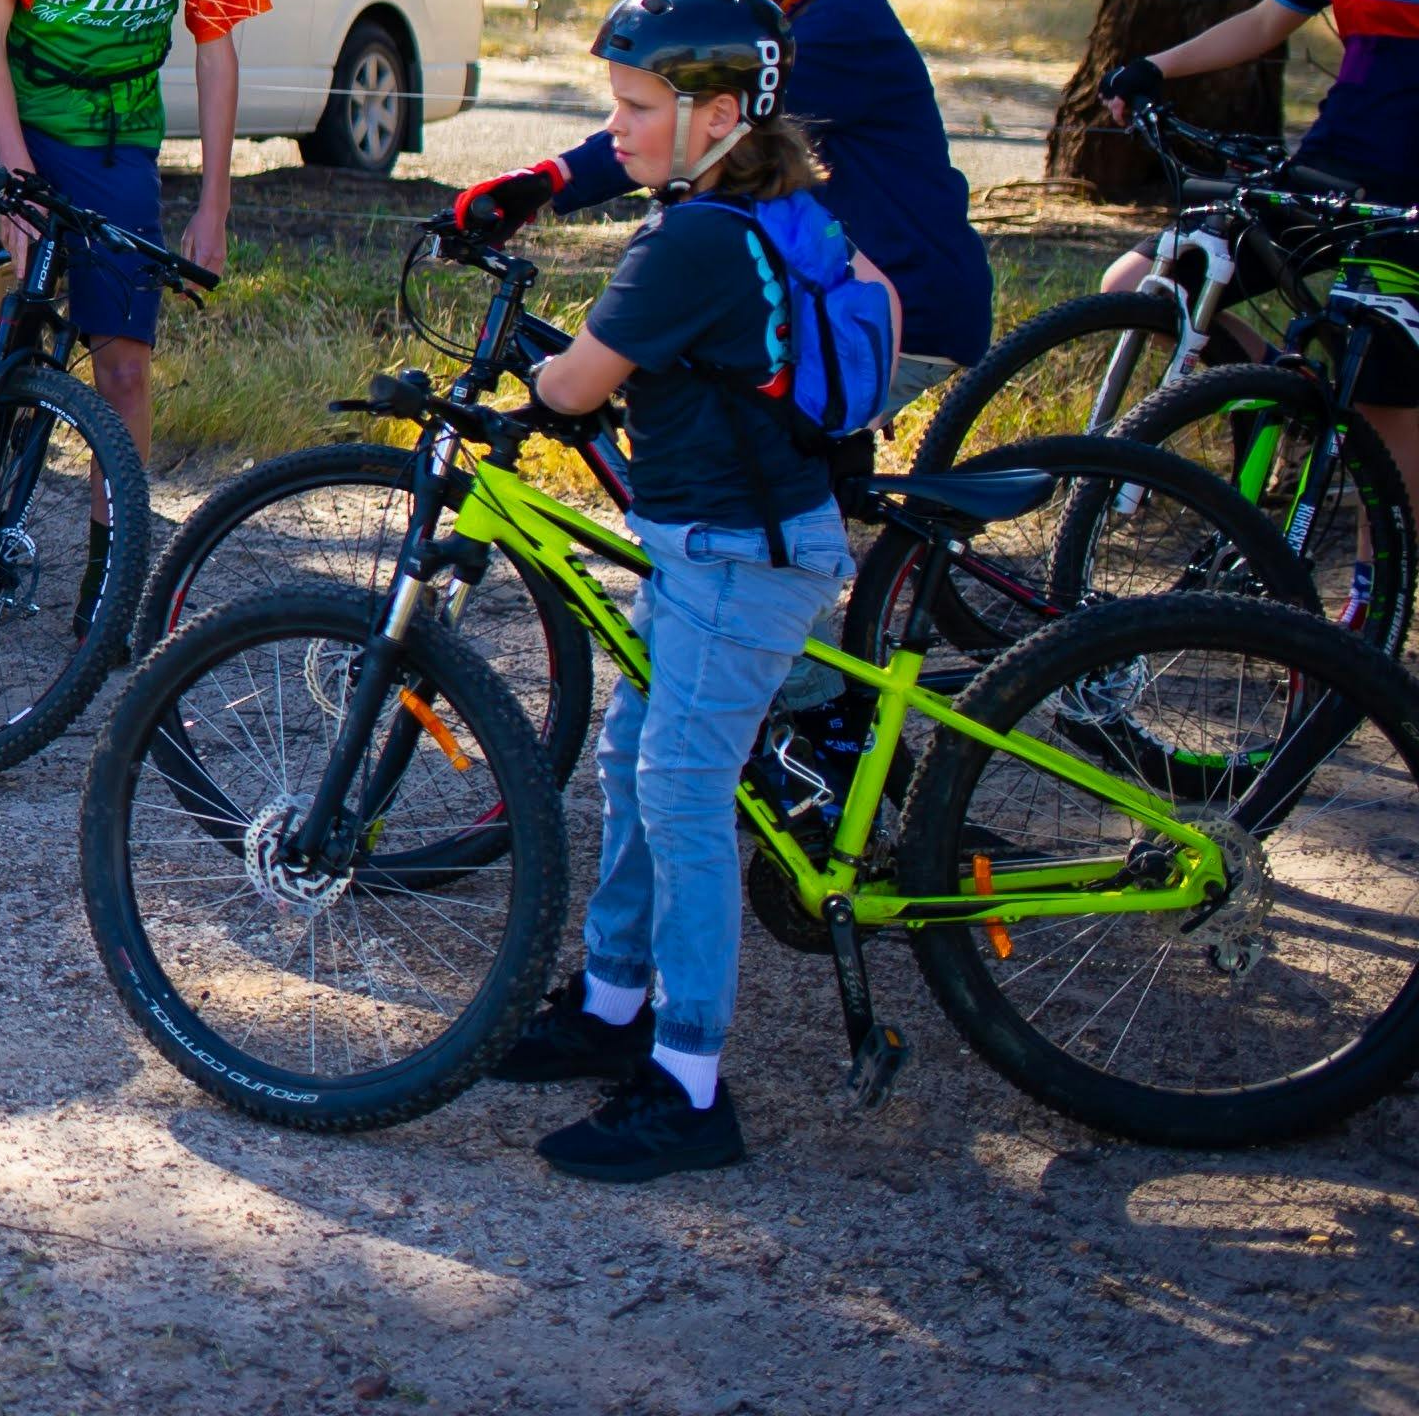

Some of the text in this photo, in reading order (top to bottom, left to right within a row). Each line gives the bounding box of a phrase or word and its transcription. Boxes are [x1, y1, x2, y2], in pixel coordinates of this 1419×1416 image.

[30, 4, 65, 24] Off
[67, 12, 119, 27] Road
[756, 39, 780, 117] POC
[36, 239, 56, 292] FOCUS
[149, 997, 320, 1105] GROUND CONTROL
